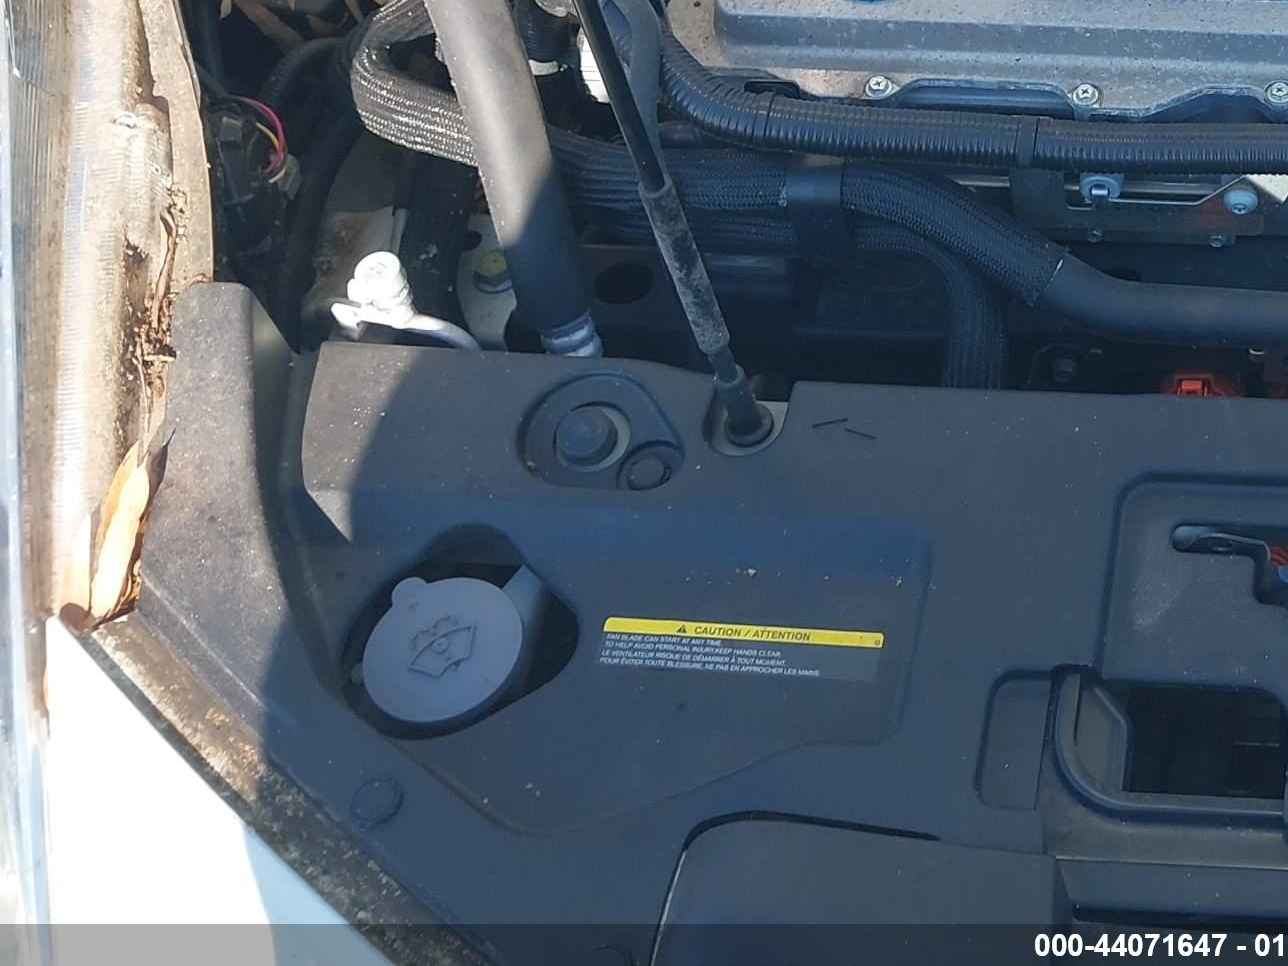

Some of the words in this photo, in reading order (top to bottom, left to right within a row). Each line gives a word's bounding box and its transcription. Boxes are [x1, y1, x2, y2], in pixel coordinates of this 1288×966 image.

[694, 625, 742, 638] CAUTION
[743, 629, 751, 639] /
[752, 628, 811, 641] ATTENTION
[655, 644, 691, 652] PERSONAL
[611, 649, 654, 658] VENTILATEUR
[655, 652, 681, 660] RISQUE
[692, 653, 730, 663] DÉMARRER
[620, 657, 644, 665] ÉVITER
[645, 659, 666, 667] TOUTE
[716, 664, 729, 672] PAS
[740, 666, 784, 675] APPROCHER
[784, 668, 797, 676] LES
